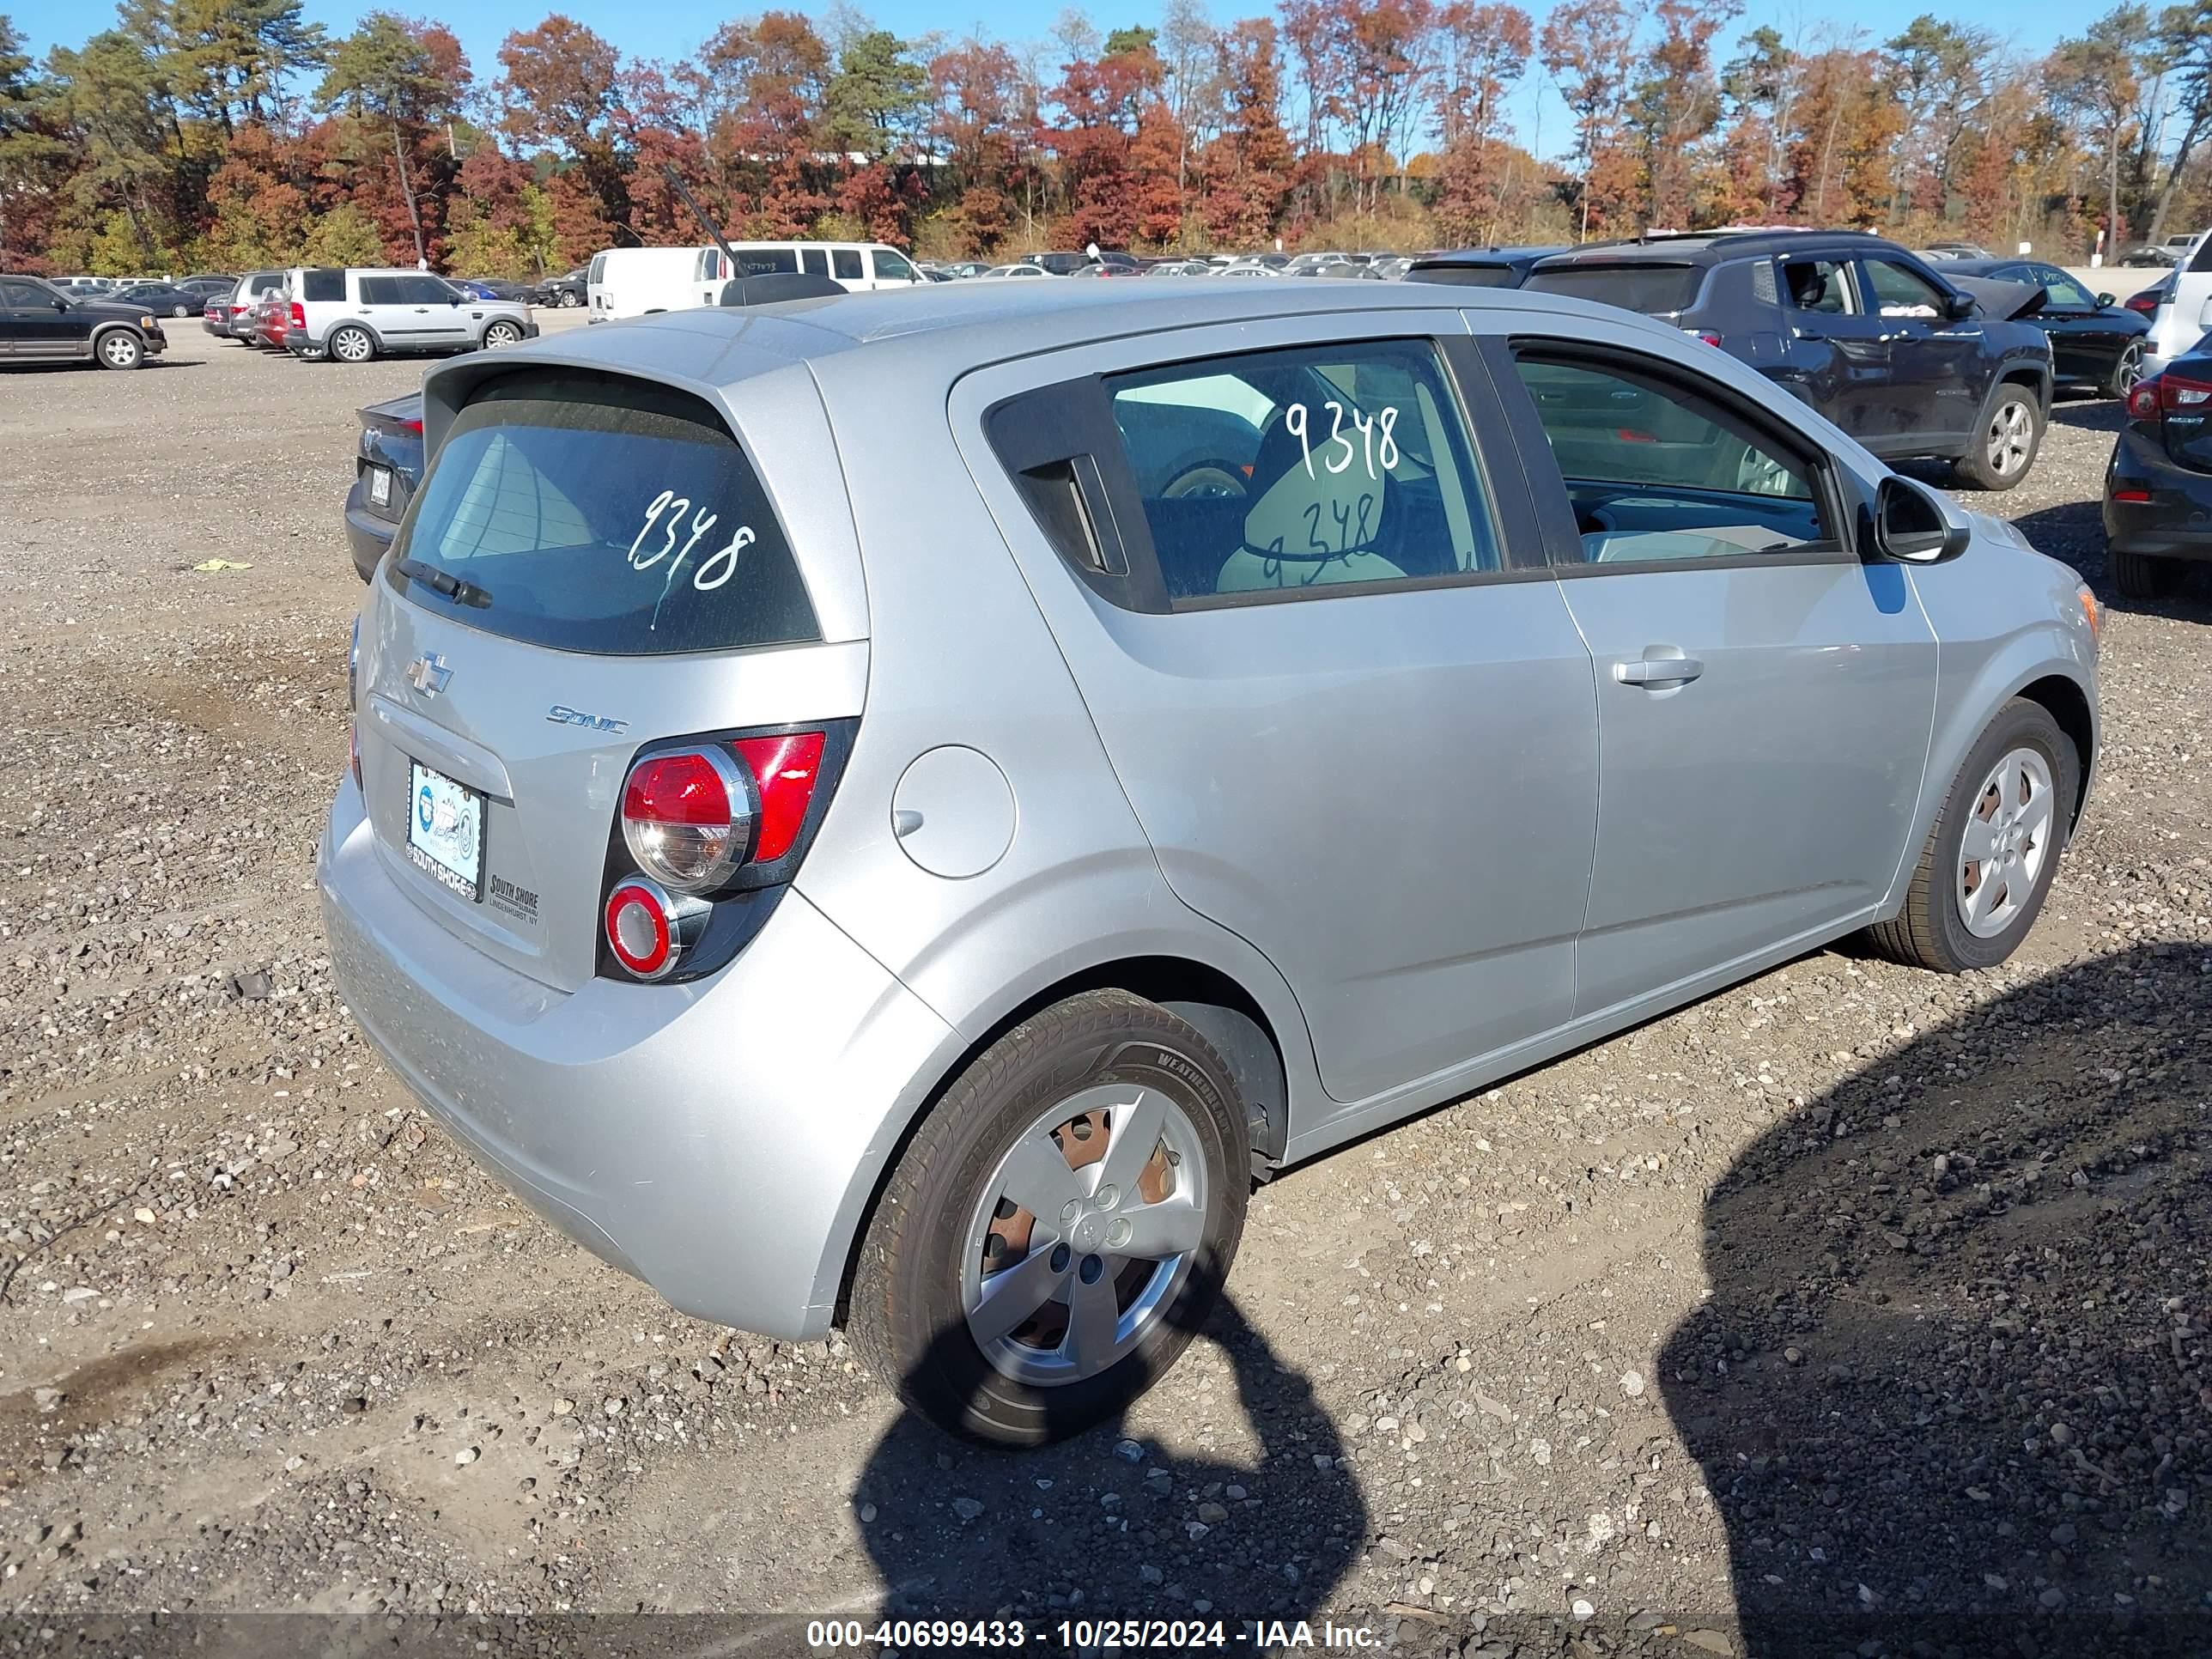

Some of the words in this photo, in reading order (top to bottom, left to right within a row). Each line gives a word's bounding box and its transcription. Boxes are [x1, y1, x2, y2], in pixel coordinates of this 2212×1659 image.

[1286, 401, 1399, 481] 9348
[628, 489, 756, 591] 9348
[545, 704, 631, 735] SONIC
[412, 846, 437, 878] SOUTH
[437, 864, 467, 897] SHORE
[489, 874, 515, 899] SOUTH
[515, 886, 539, 910] SHORE
[529, 915, 538, 927] NY
